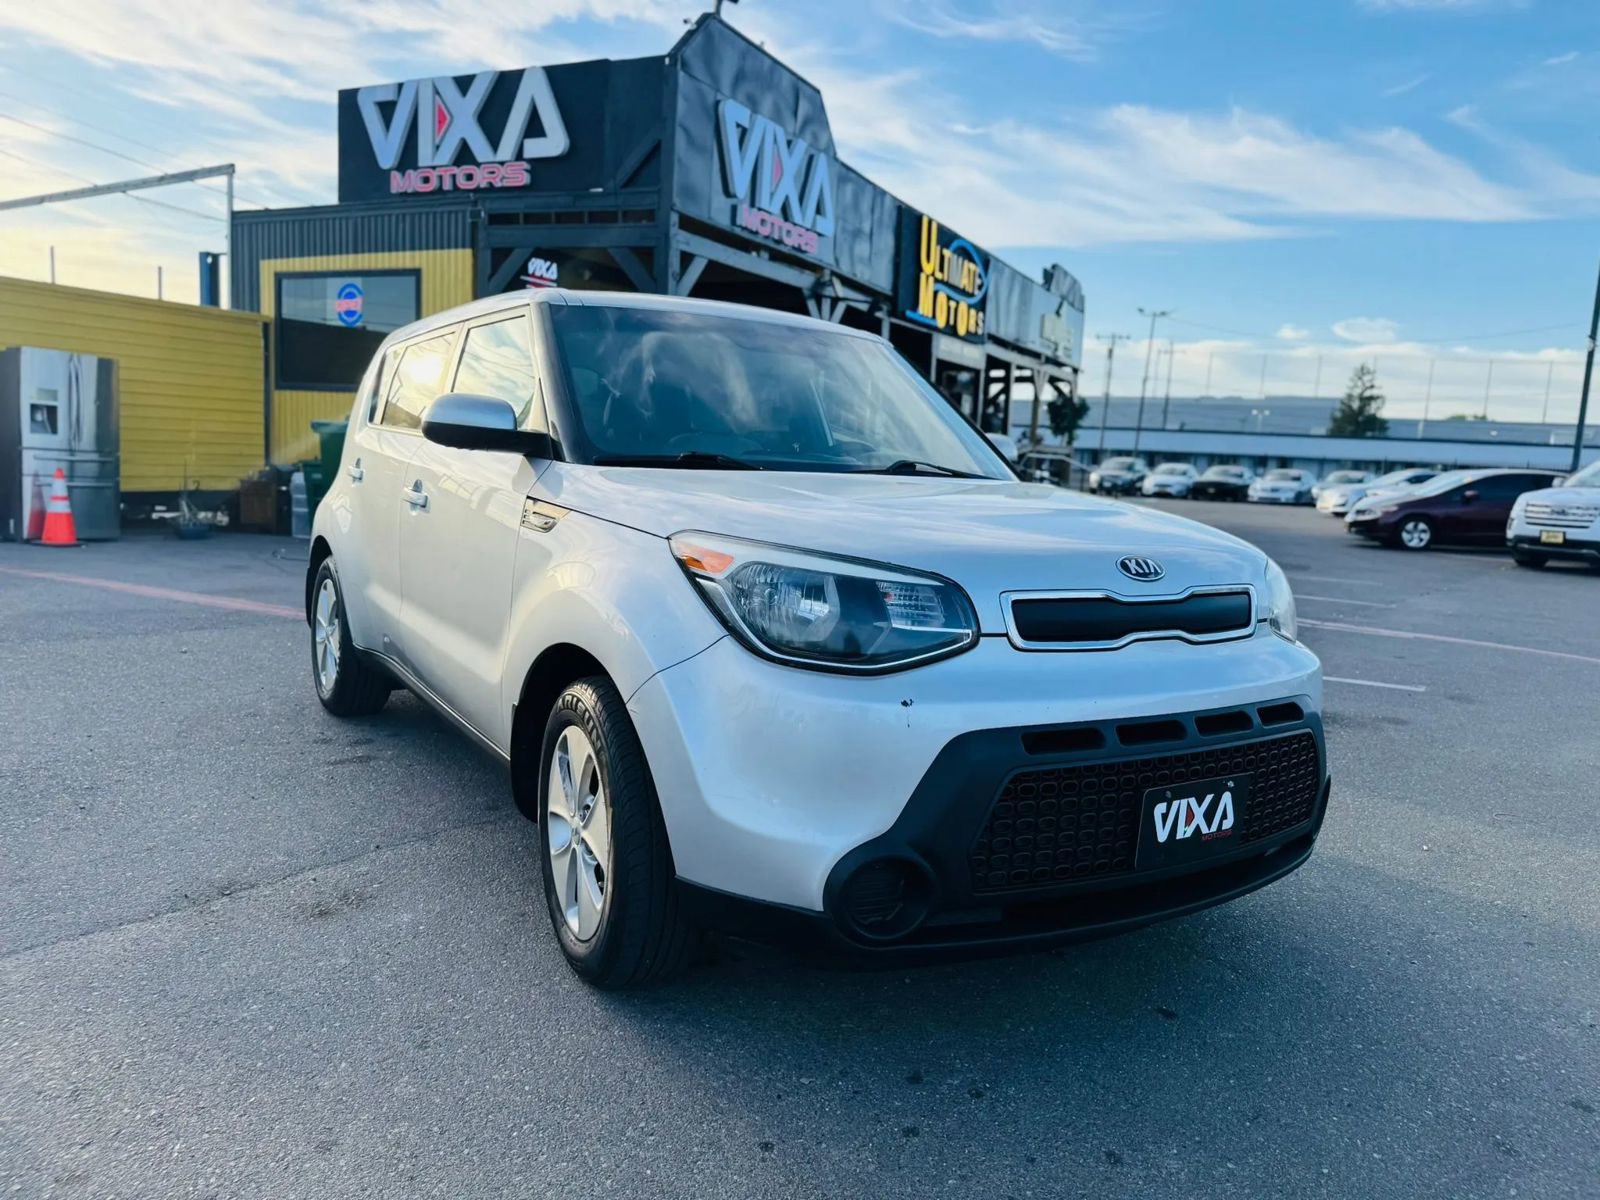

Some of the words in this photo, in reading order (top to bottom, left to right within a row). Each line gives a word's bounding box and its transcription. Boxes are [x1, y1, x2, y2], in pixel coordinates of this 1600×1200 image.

[357, 66, 570, 170] VIXA
[389, 161, 532, 194] MOTORS
[718, 98, 835, 239] VIXA
[737, 203, 818, 254] MOTORS
[918, 271, 984, 337] MOTORS
[1123, 558, 1162, 574] KIA
[1153, 790, 1235, 843] VIXA
[1201, 829, 1233, 842] MOTORS
